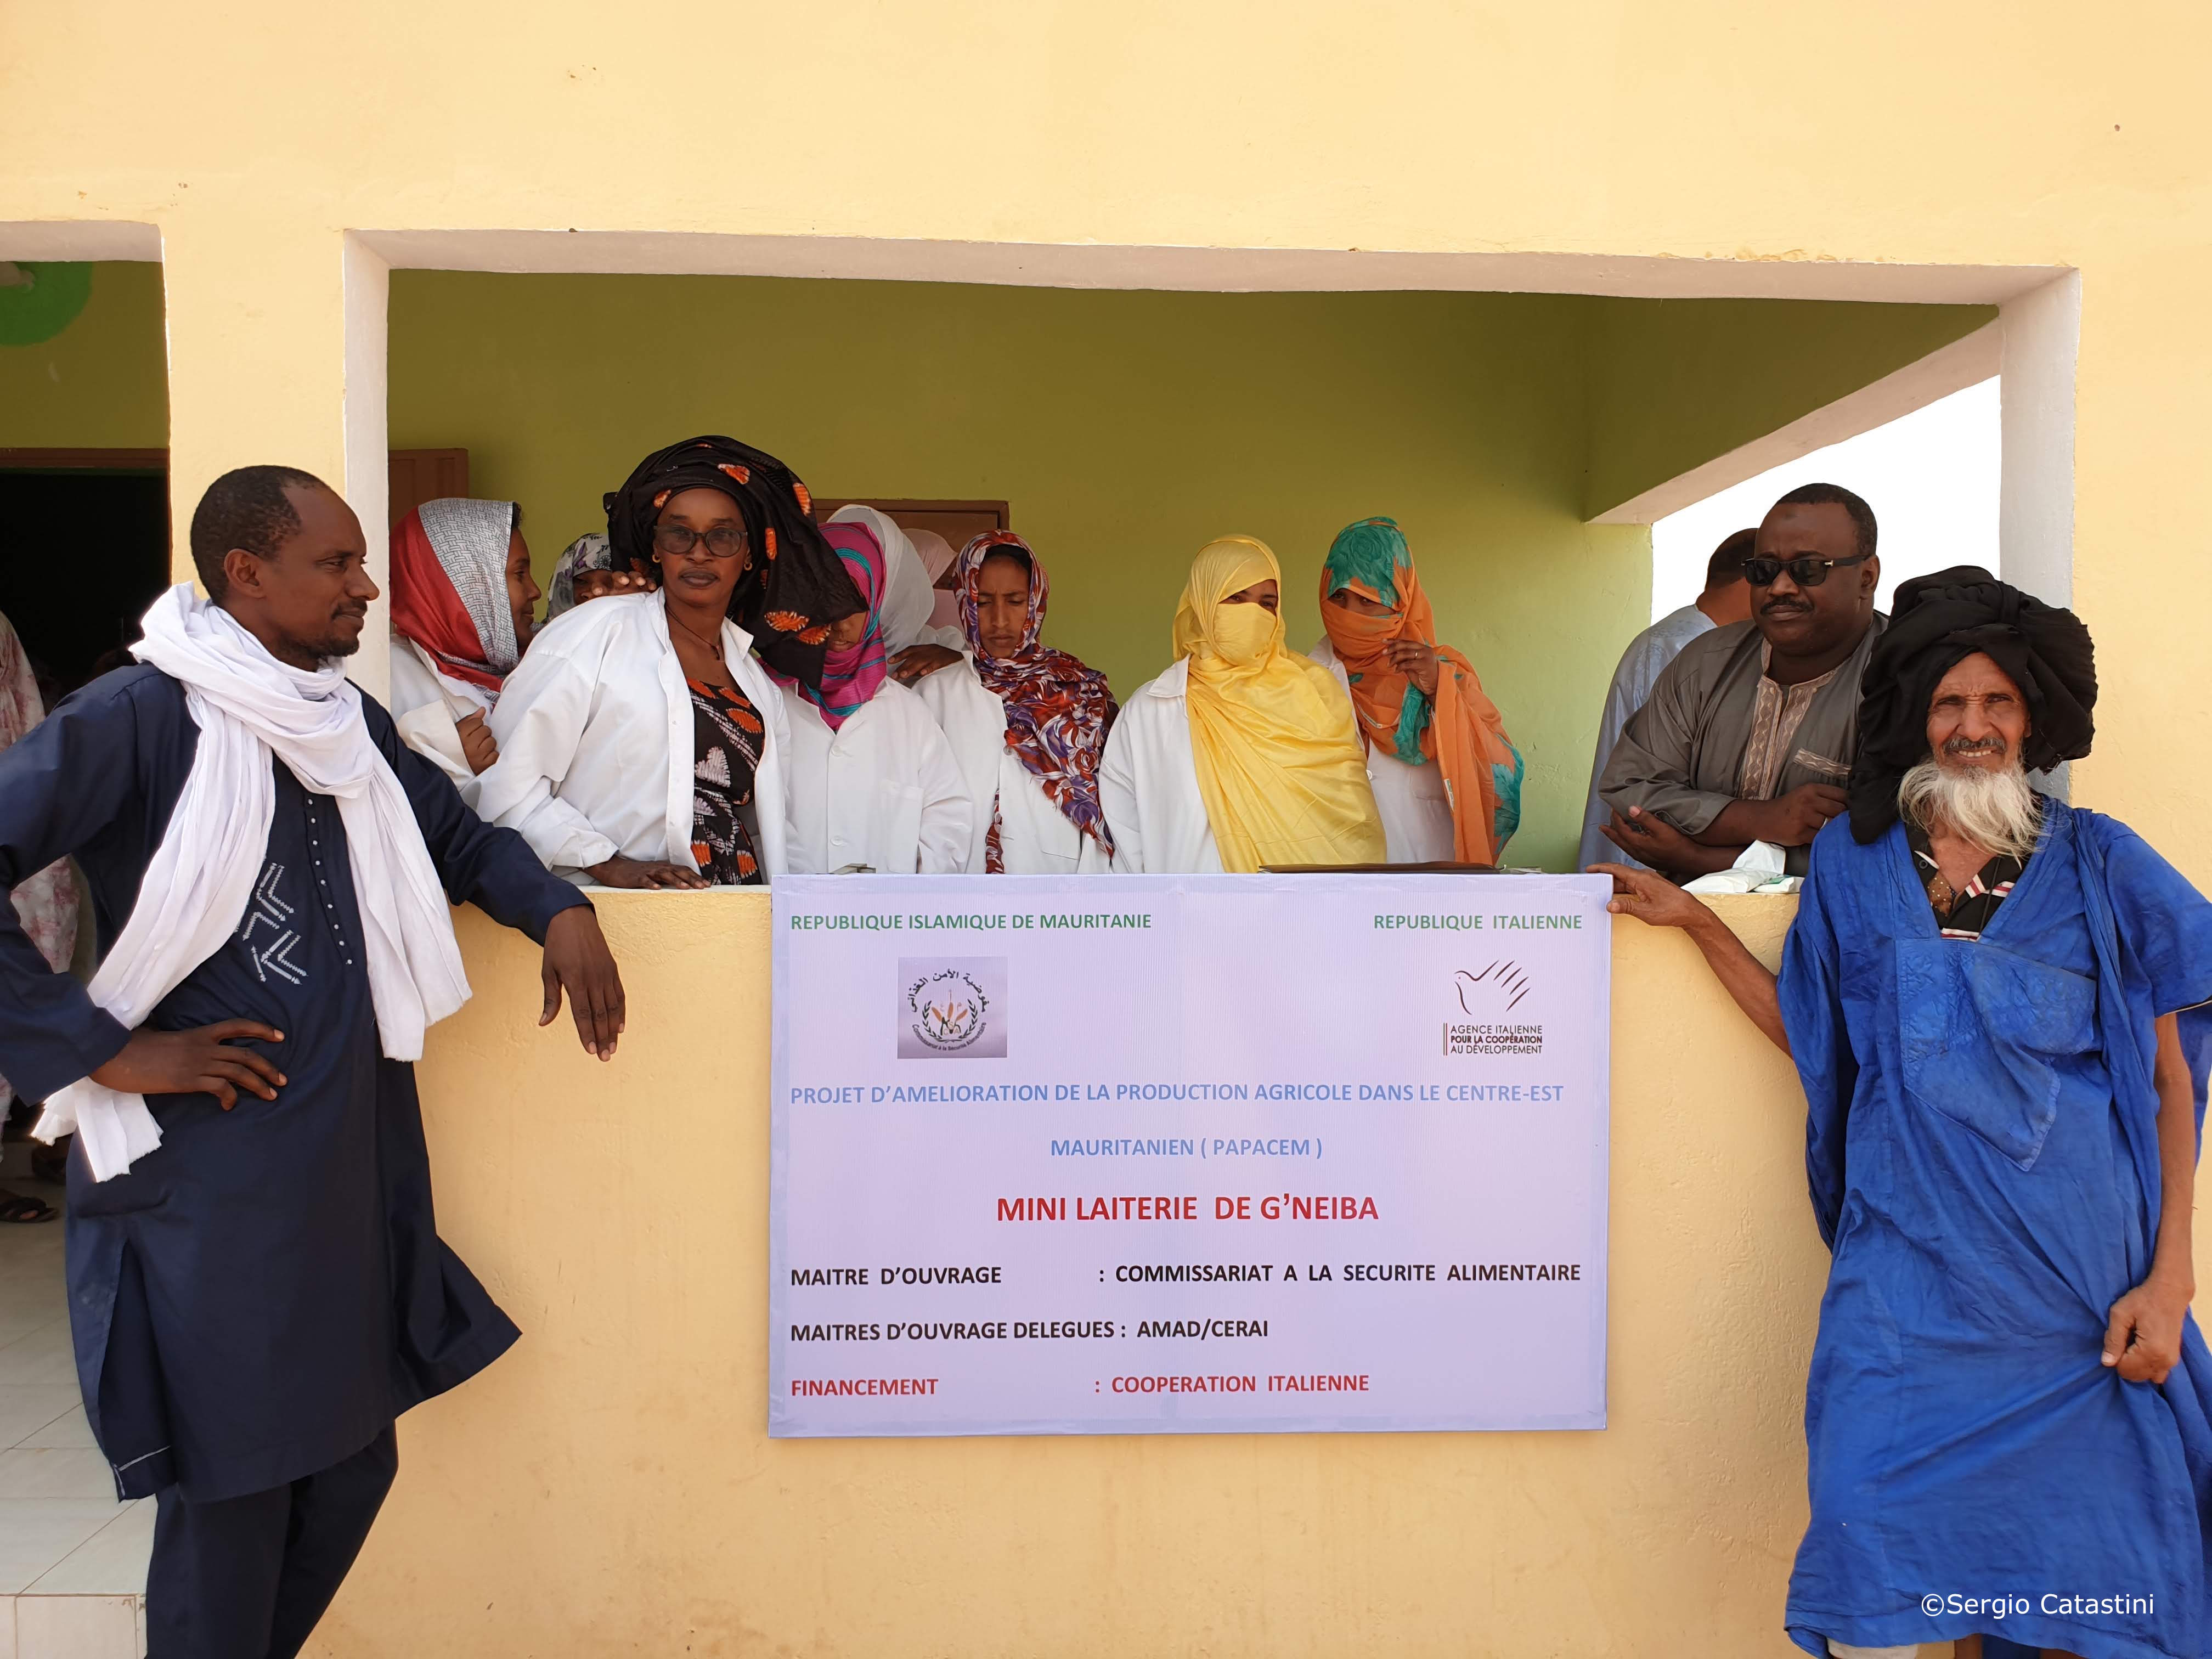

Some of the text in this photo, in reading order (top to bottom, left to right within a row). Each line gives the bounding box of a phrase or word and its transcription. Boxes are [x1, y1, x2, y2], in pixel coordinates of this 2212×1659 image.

[792, 915, 1152, 932] REPUBLIQUE ISLAMIQUE DE MAURITANIE
[1375, 915, 1583, 932] REPUBLIQUE ITALIENNE
[933, 968, 959, 981] الأمن
[1451, 1025, 1542, 1034] AGENCE ITALIENNE
[1451, 1033, 1543, 1043] POUR LA COOPÉRATION
[1451, 1043, 1543, 1054] AU DÉVELOPPEMENT
[792, 1085, 1564, 1104] PROJET D’AMELIORATION DE LA PRODUCTION AGRICOLE DANS LE CENTRE-EST
[1052, 1139, 1194, 1156] MAURITANIEN
[1214, 1139, 1310, 1156] PAPACEM
[998, 1193, 1380, 1222] MINI LAITERIE DE G’NEIBA
[792, 1269, 870, 1287] MAITRE
[882, 1267, 1002, 1285] D’OUVRAGE
[1116, 1265, 1274, 1283] COMMISSARIAT
[1284, 1265, 1299, 1282] A
[1310, 1265, 1333, 1282] LA
[1344, 1265, 1436, 1282] SECURITE
[1447, 1265, 1581, 1282] ALIMENTAIRE
[792, 1324, 881, 1342] MAITRES
[888, 1322, 1008, 1341] D’OUVRAGE
[1014, 1321, 1115, 1339] DELEGUES
[1137, 1318, 1268, 1341] AMAD/CERAI
[792, 1379, 939, 1397] FINANCEMENT
[1112, 1376, 1256, 1394] COOPERATION
[1269, 1375, 1370, 1392] ITALIENNE
